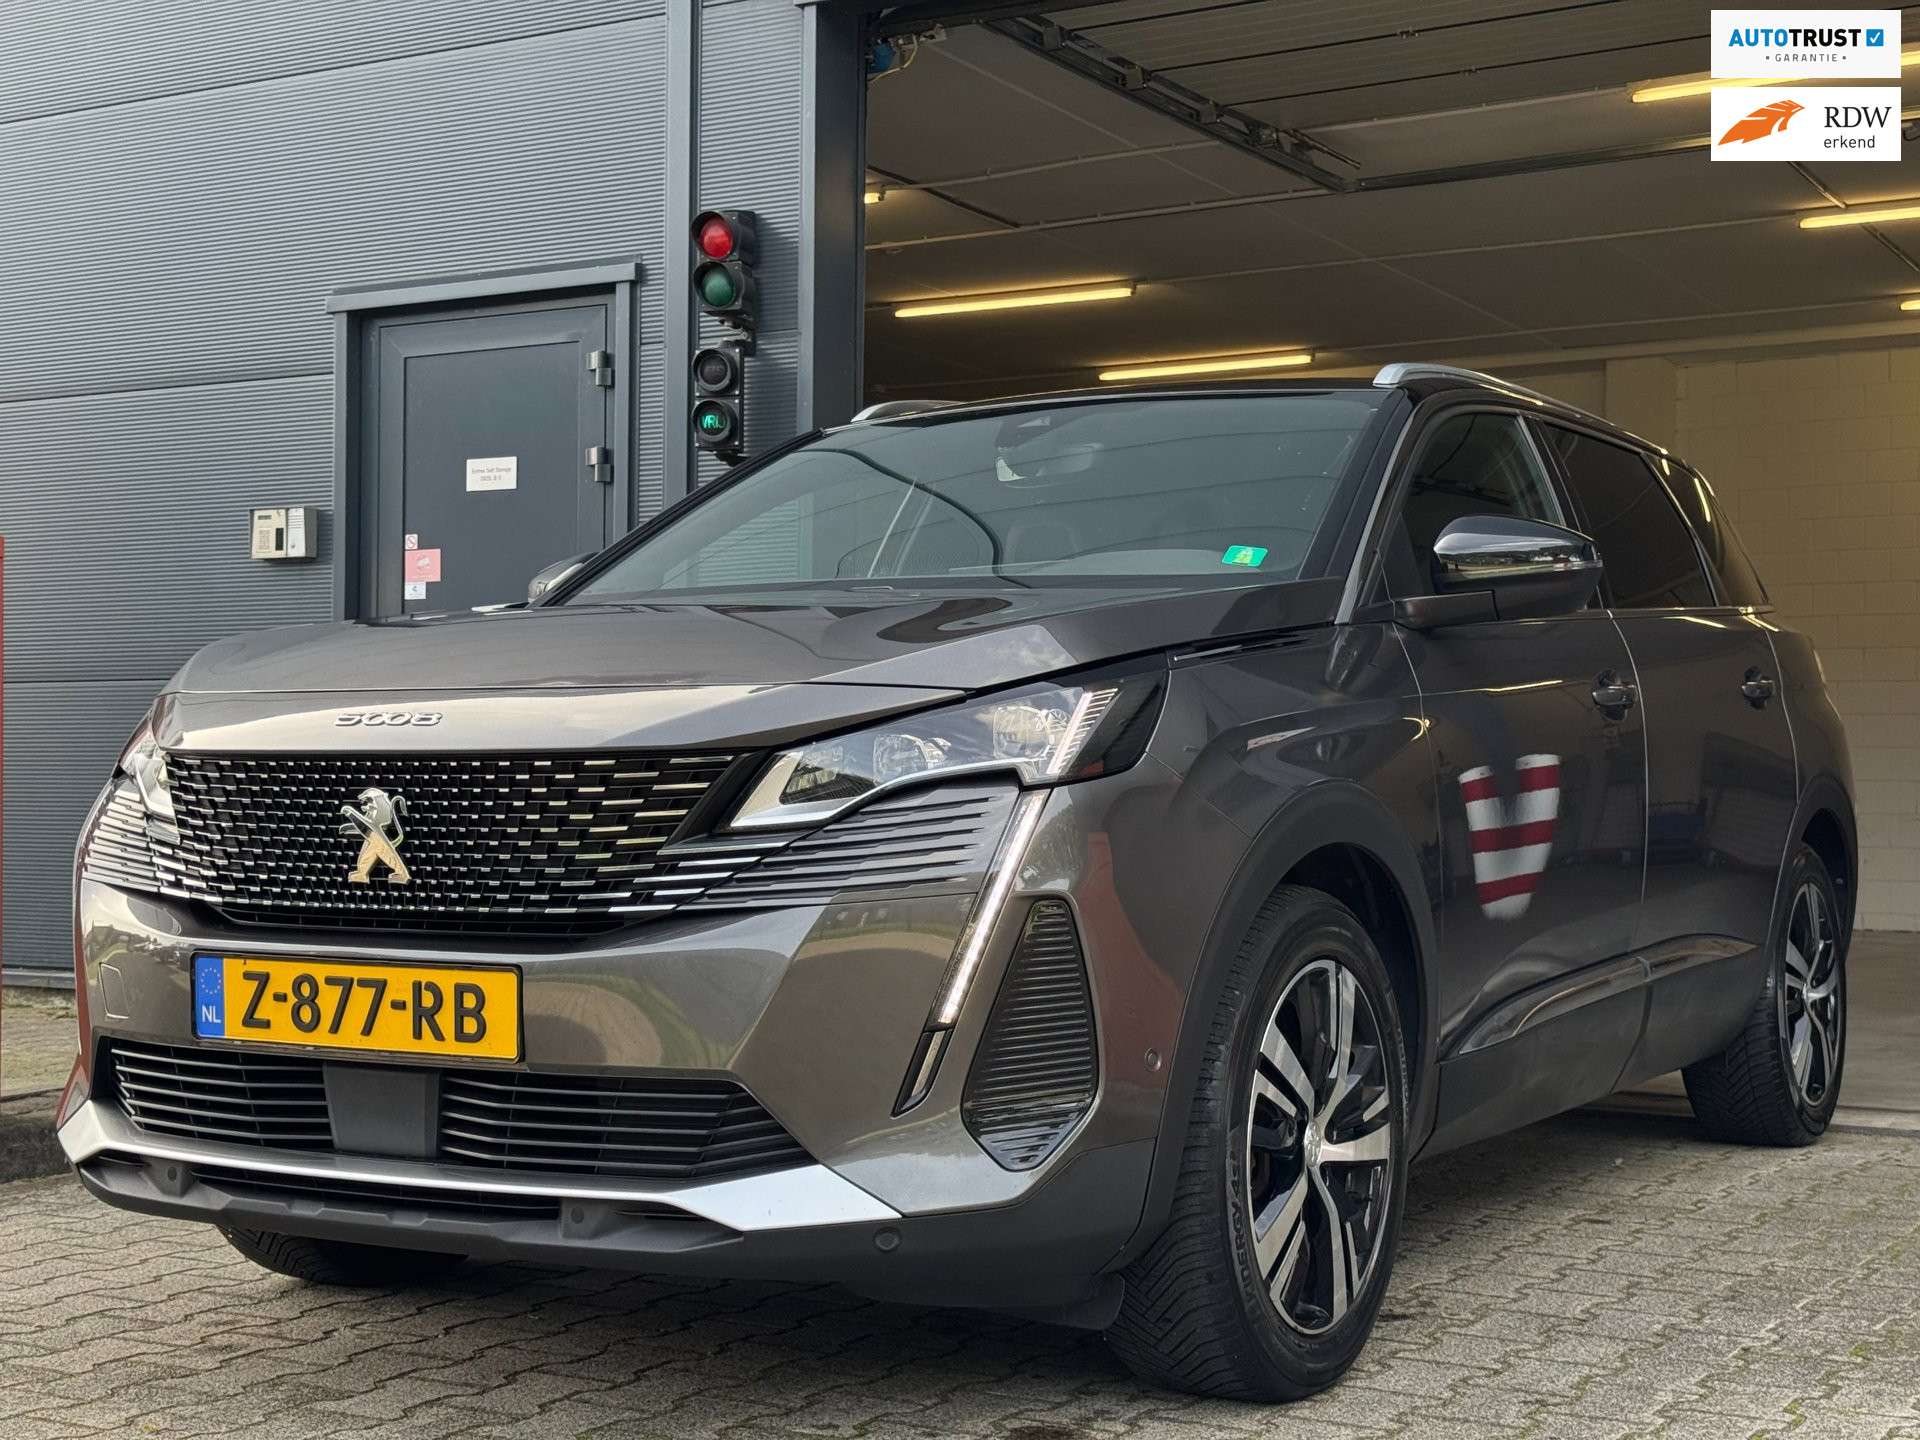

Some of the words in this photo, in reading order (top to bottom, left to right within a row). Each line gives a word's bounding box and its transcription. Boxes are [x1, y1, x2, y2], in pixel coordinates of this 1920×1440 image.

[334, 712, 443, 727] 5008
[201, 1005, 221, 1024] NL
[241, 970, 487, 1044] Z-877-RB
